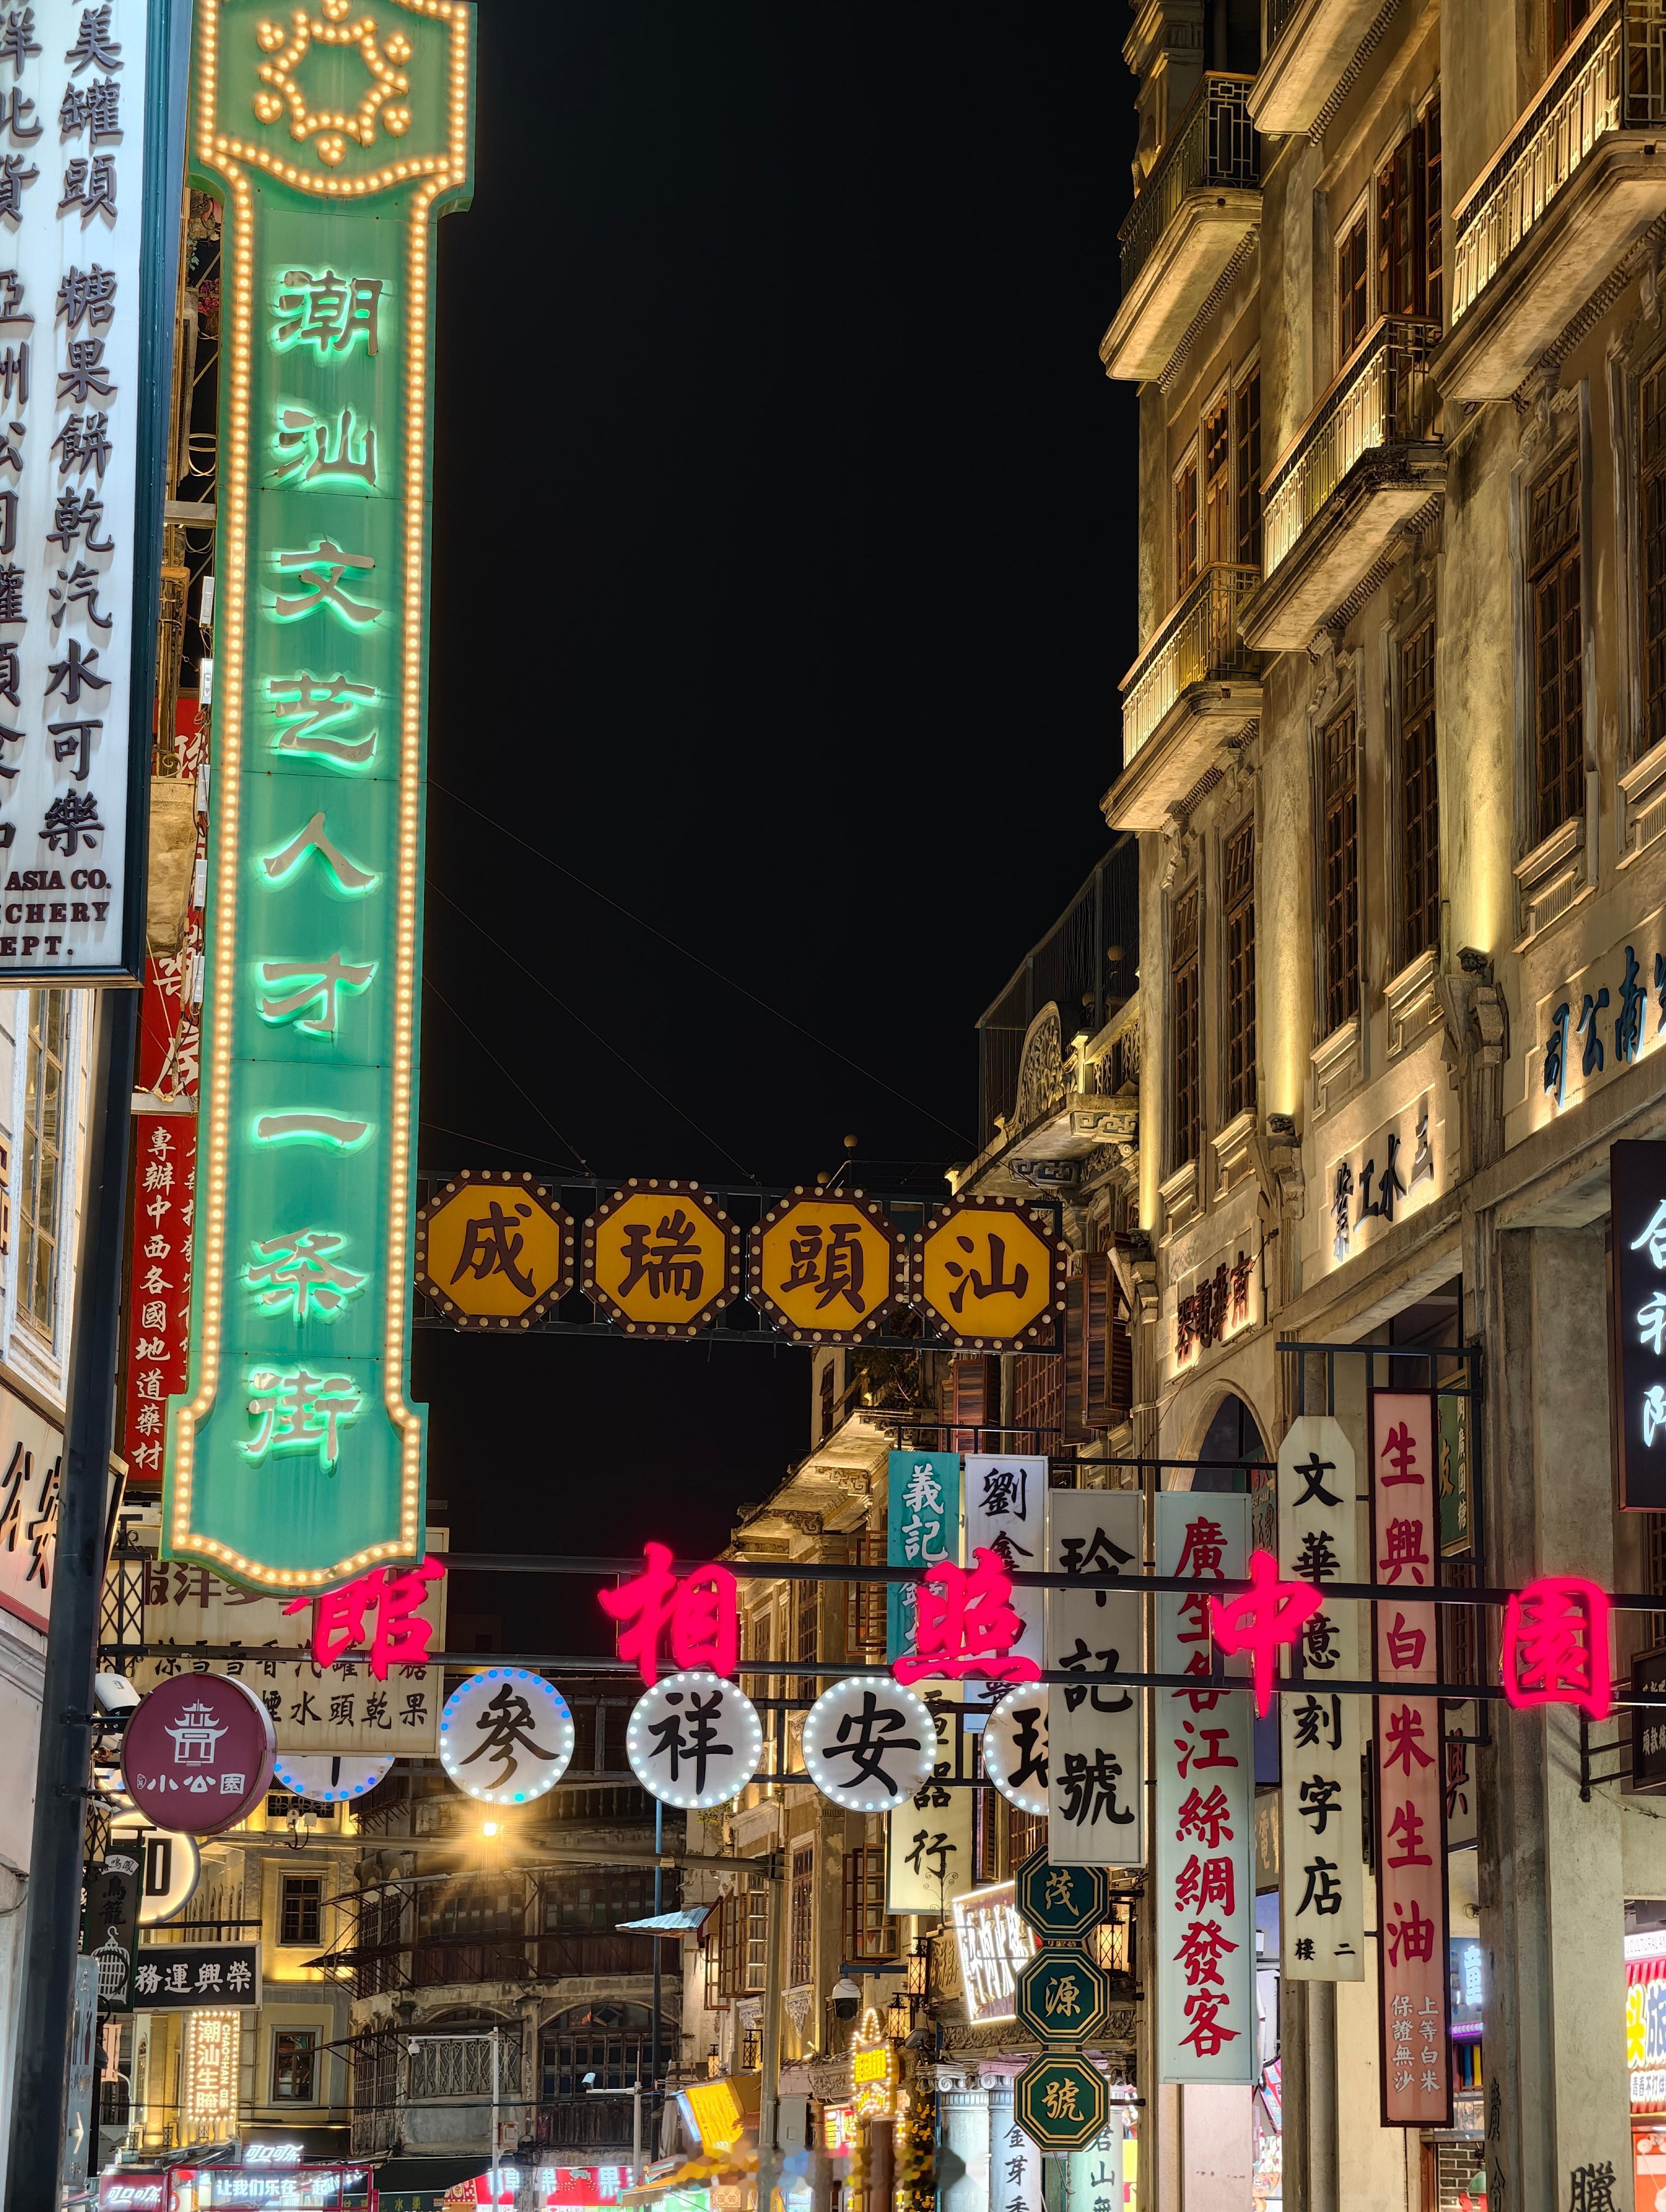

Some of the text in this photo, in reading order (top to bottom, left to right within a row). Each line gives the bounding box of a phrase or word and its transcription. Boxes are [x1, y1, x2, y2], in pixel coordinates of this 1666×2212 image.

[58, 0, 125, 218] 美罐頭
[0, 902, 110, 924] CHERY
[5, 869, 112, 891] ASIA CO.
[247, 269, 384, 1462] 潮汕文艺人才一条街
[131, 1126, 176, 1471] 專辦中西各國地道藥材
[1292, 1452, 1344, 1917] 文華意刻字店
[147, 1773, 246, 1795] 小公園
[1041, 1871, 1085, 2123] 茂源號
[1391, 1995, 1415, 2093] 保證無沙
[1417, 1996, 1441, 2093] 上等白米
[196, 2020, 221, 2113] 潮汕生腌
[221, 2024, 231, 2085] CHAOSHAN
[107, 2185, 163, 2204] 可口可乐
[217, 2179, 329, 2196] 让我们乐在起
